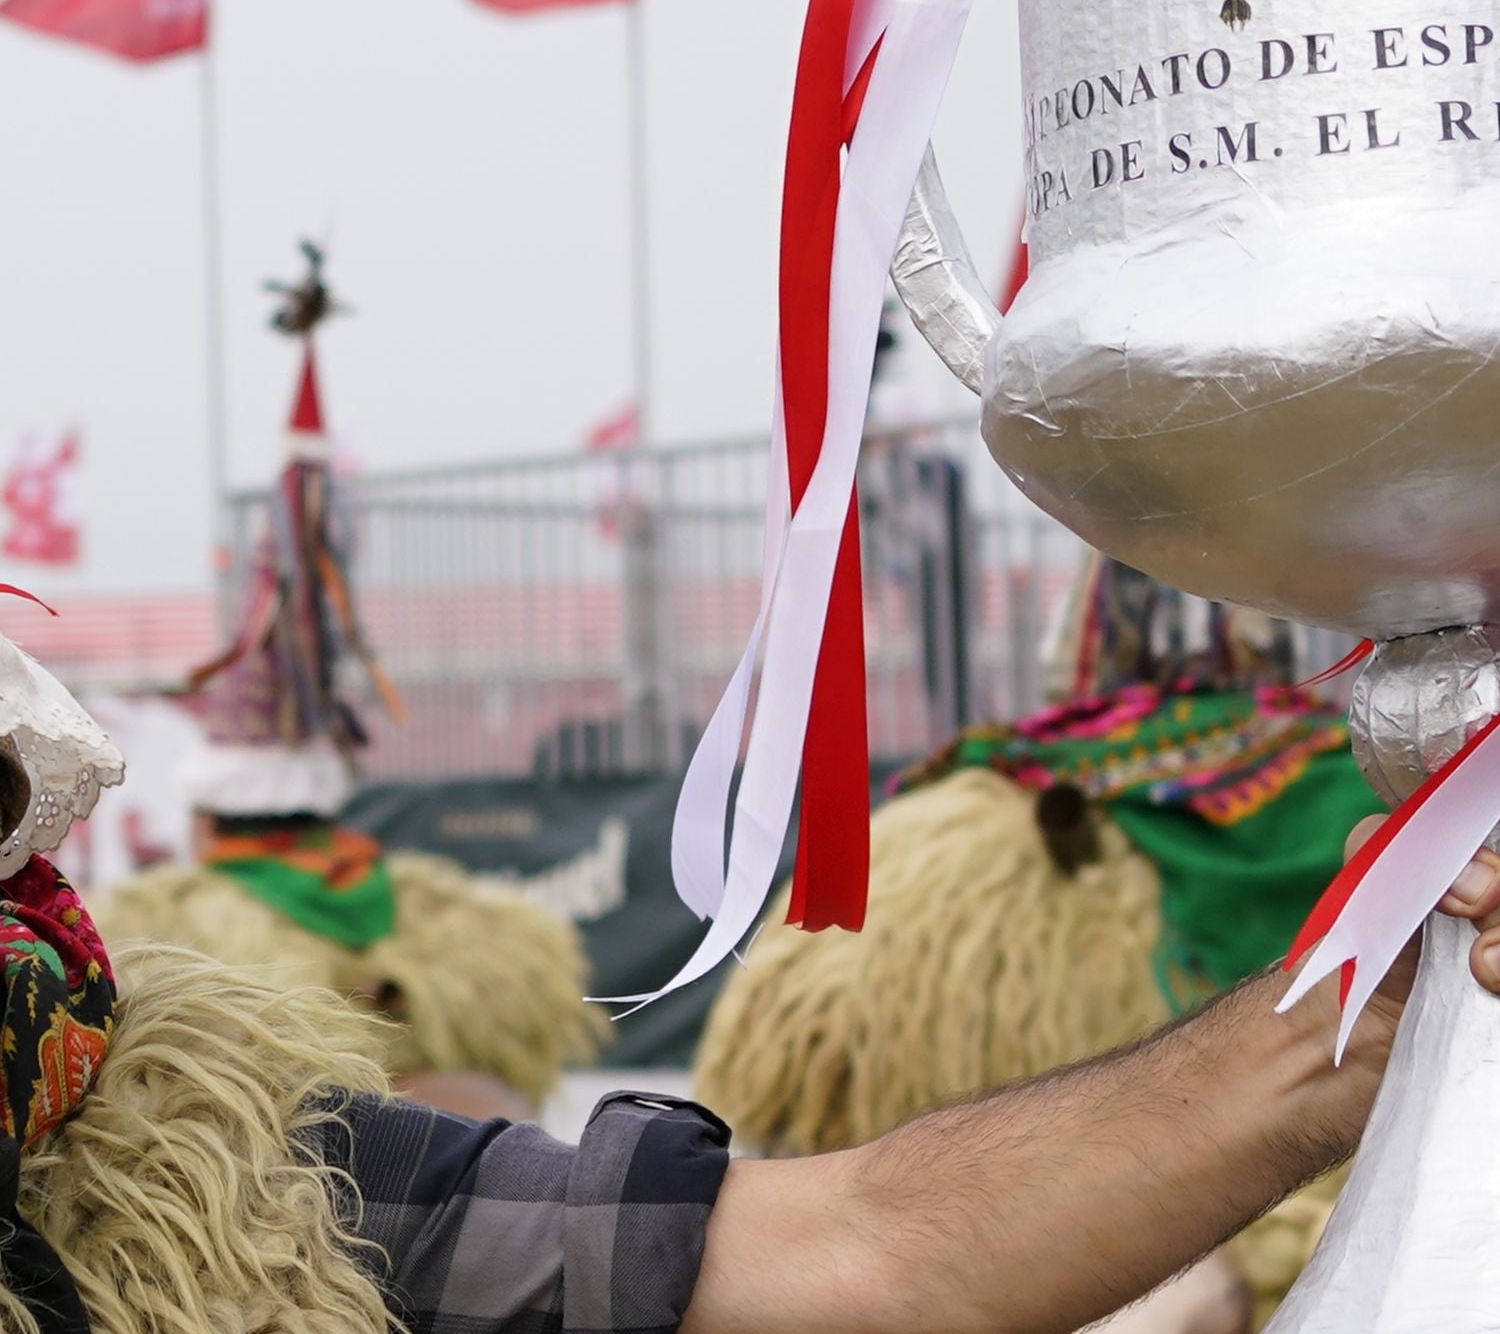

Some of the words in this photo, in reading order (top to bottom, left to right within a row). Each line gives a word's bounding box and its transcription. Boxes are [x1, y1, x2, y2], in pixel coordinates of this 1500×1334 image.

[1024, 48, 1231, 145] MPEONATO
[1258, 33, 1337, 81] DE
[1029, 164, 1073, 217] OPA
[1090, 140, 1144, 189] DE
[1168, 122, 1283, 174] S.M.
[1315, 105, 1401, 157] EL
